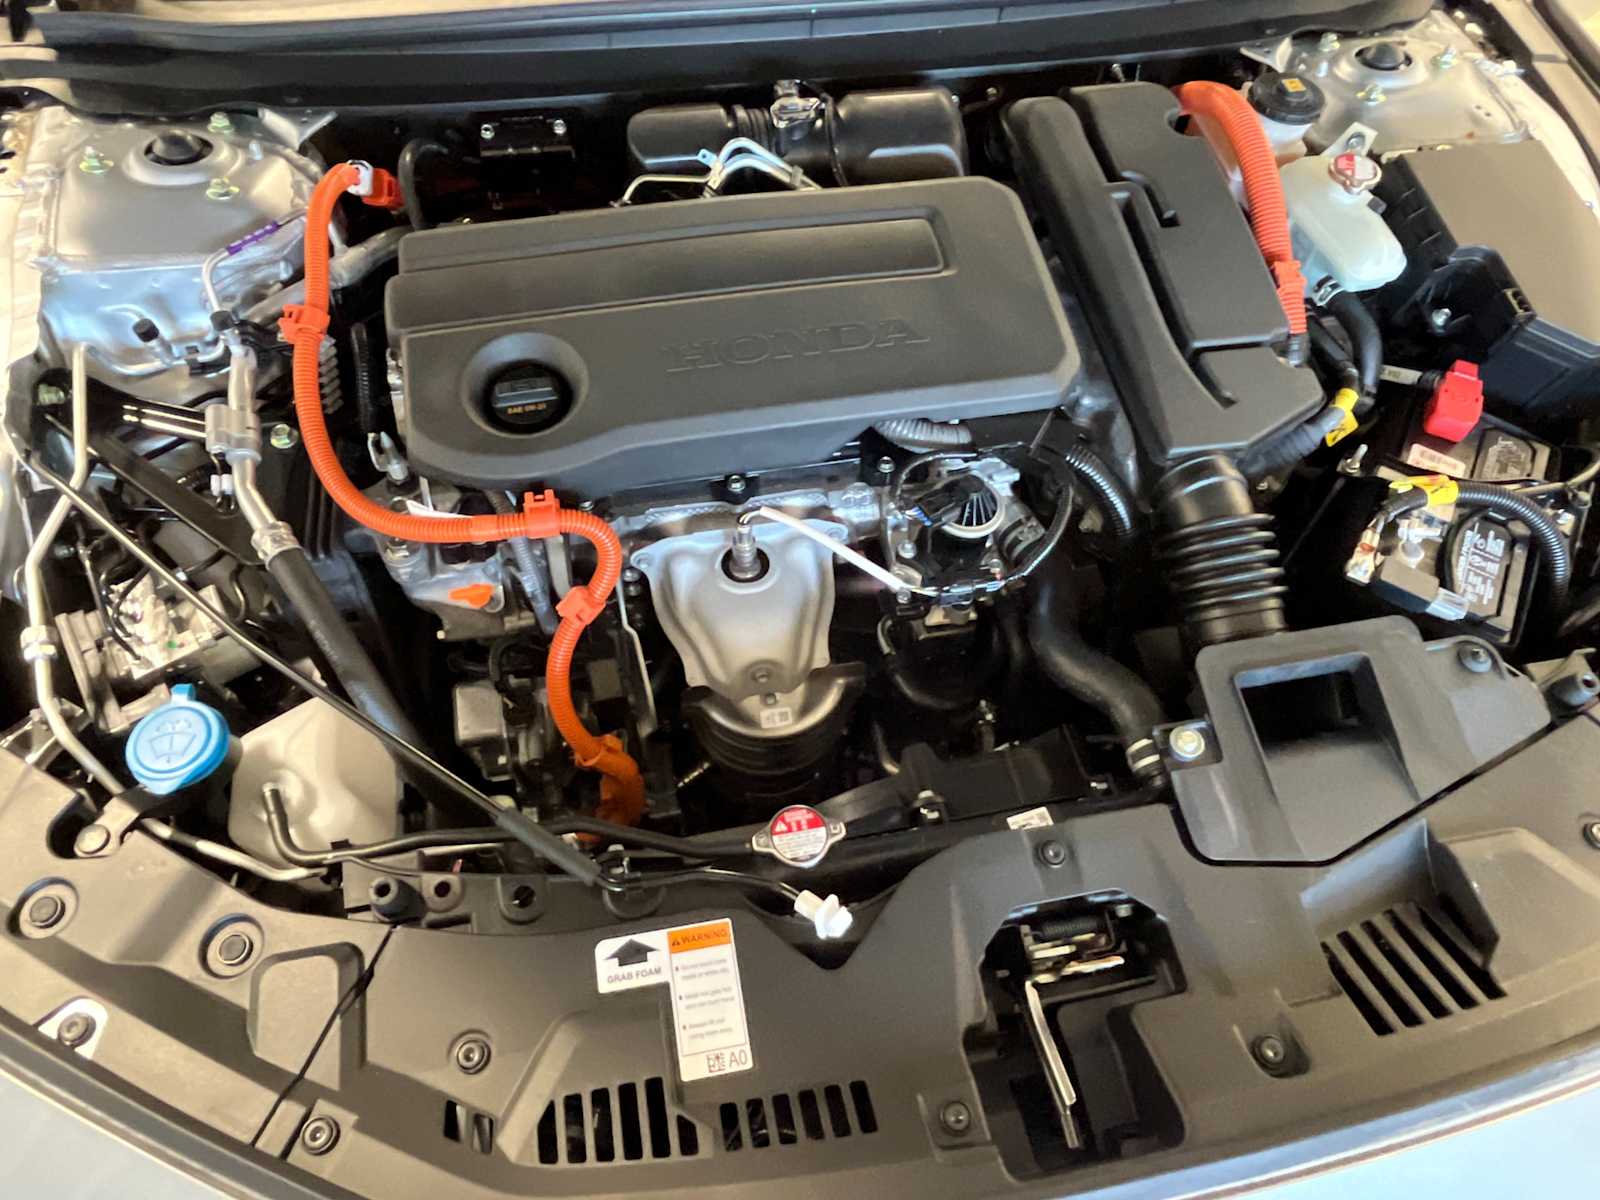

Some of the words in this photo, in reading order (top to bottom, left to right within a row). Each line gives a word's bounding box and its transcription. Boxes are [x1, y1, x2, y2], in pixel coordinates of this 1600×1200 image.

[661, 317, 931, 372] HONDA
[681, 928, 728, 944] WARNING
[607, 969, 633, 984] GRAB
[635, 966, 662, 979] FOAM
